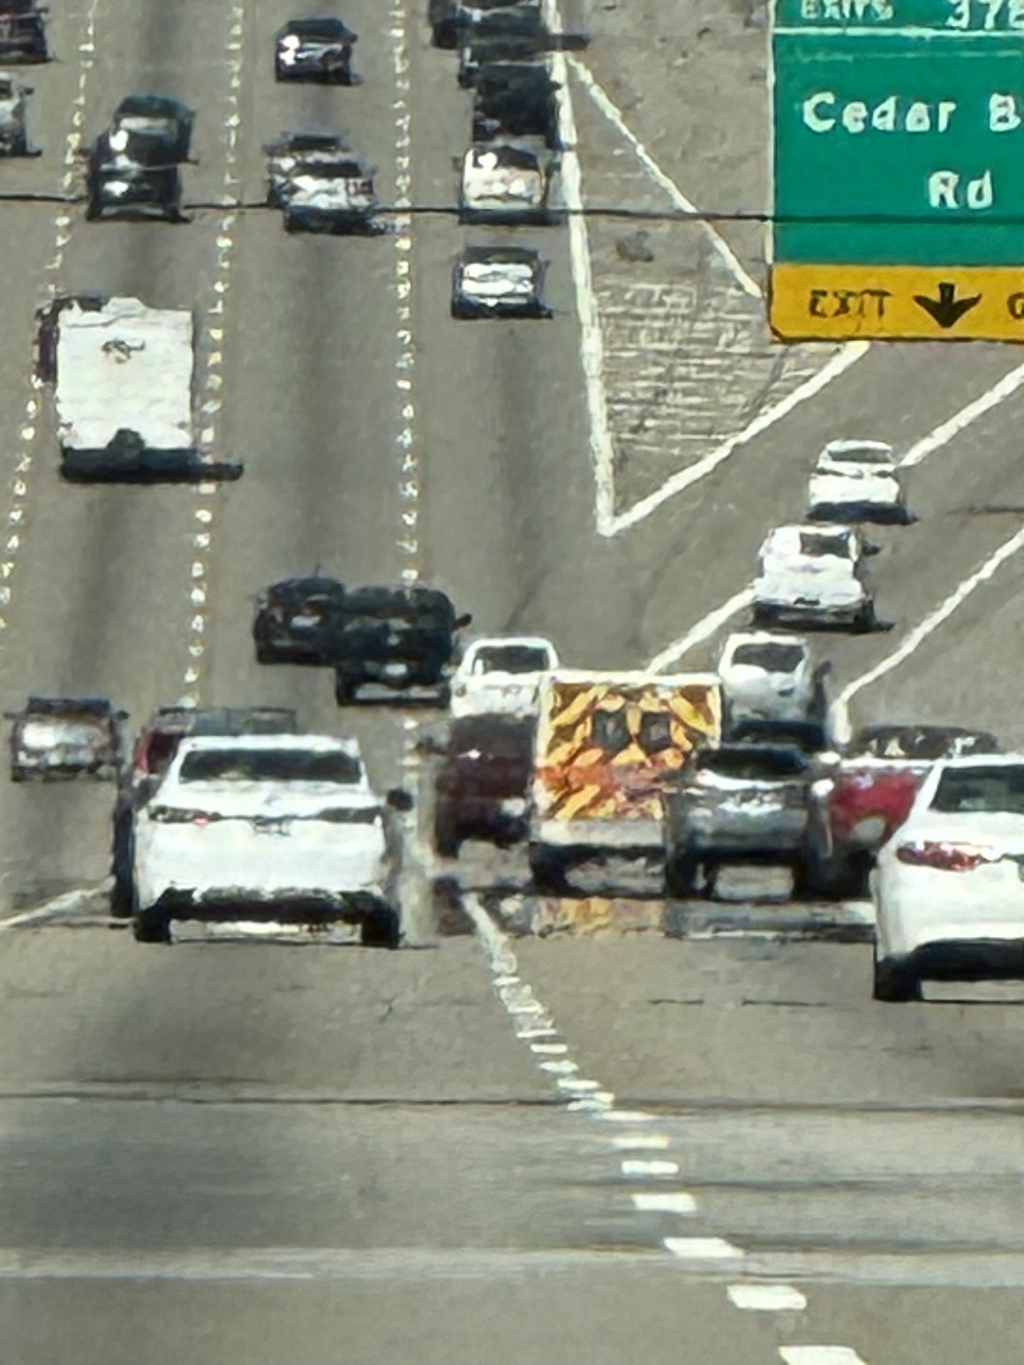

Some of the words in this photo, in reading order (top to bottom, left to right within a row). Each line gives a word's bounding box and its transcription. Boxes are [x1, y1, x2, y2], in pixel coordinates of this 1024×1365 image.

[803, 91, 957, 133] Cedar
[929, 170, 993, 210] Rd
[809, 289, 892, 321] EXIT
